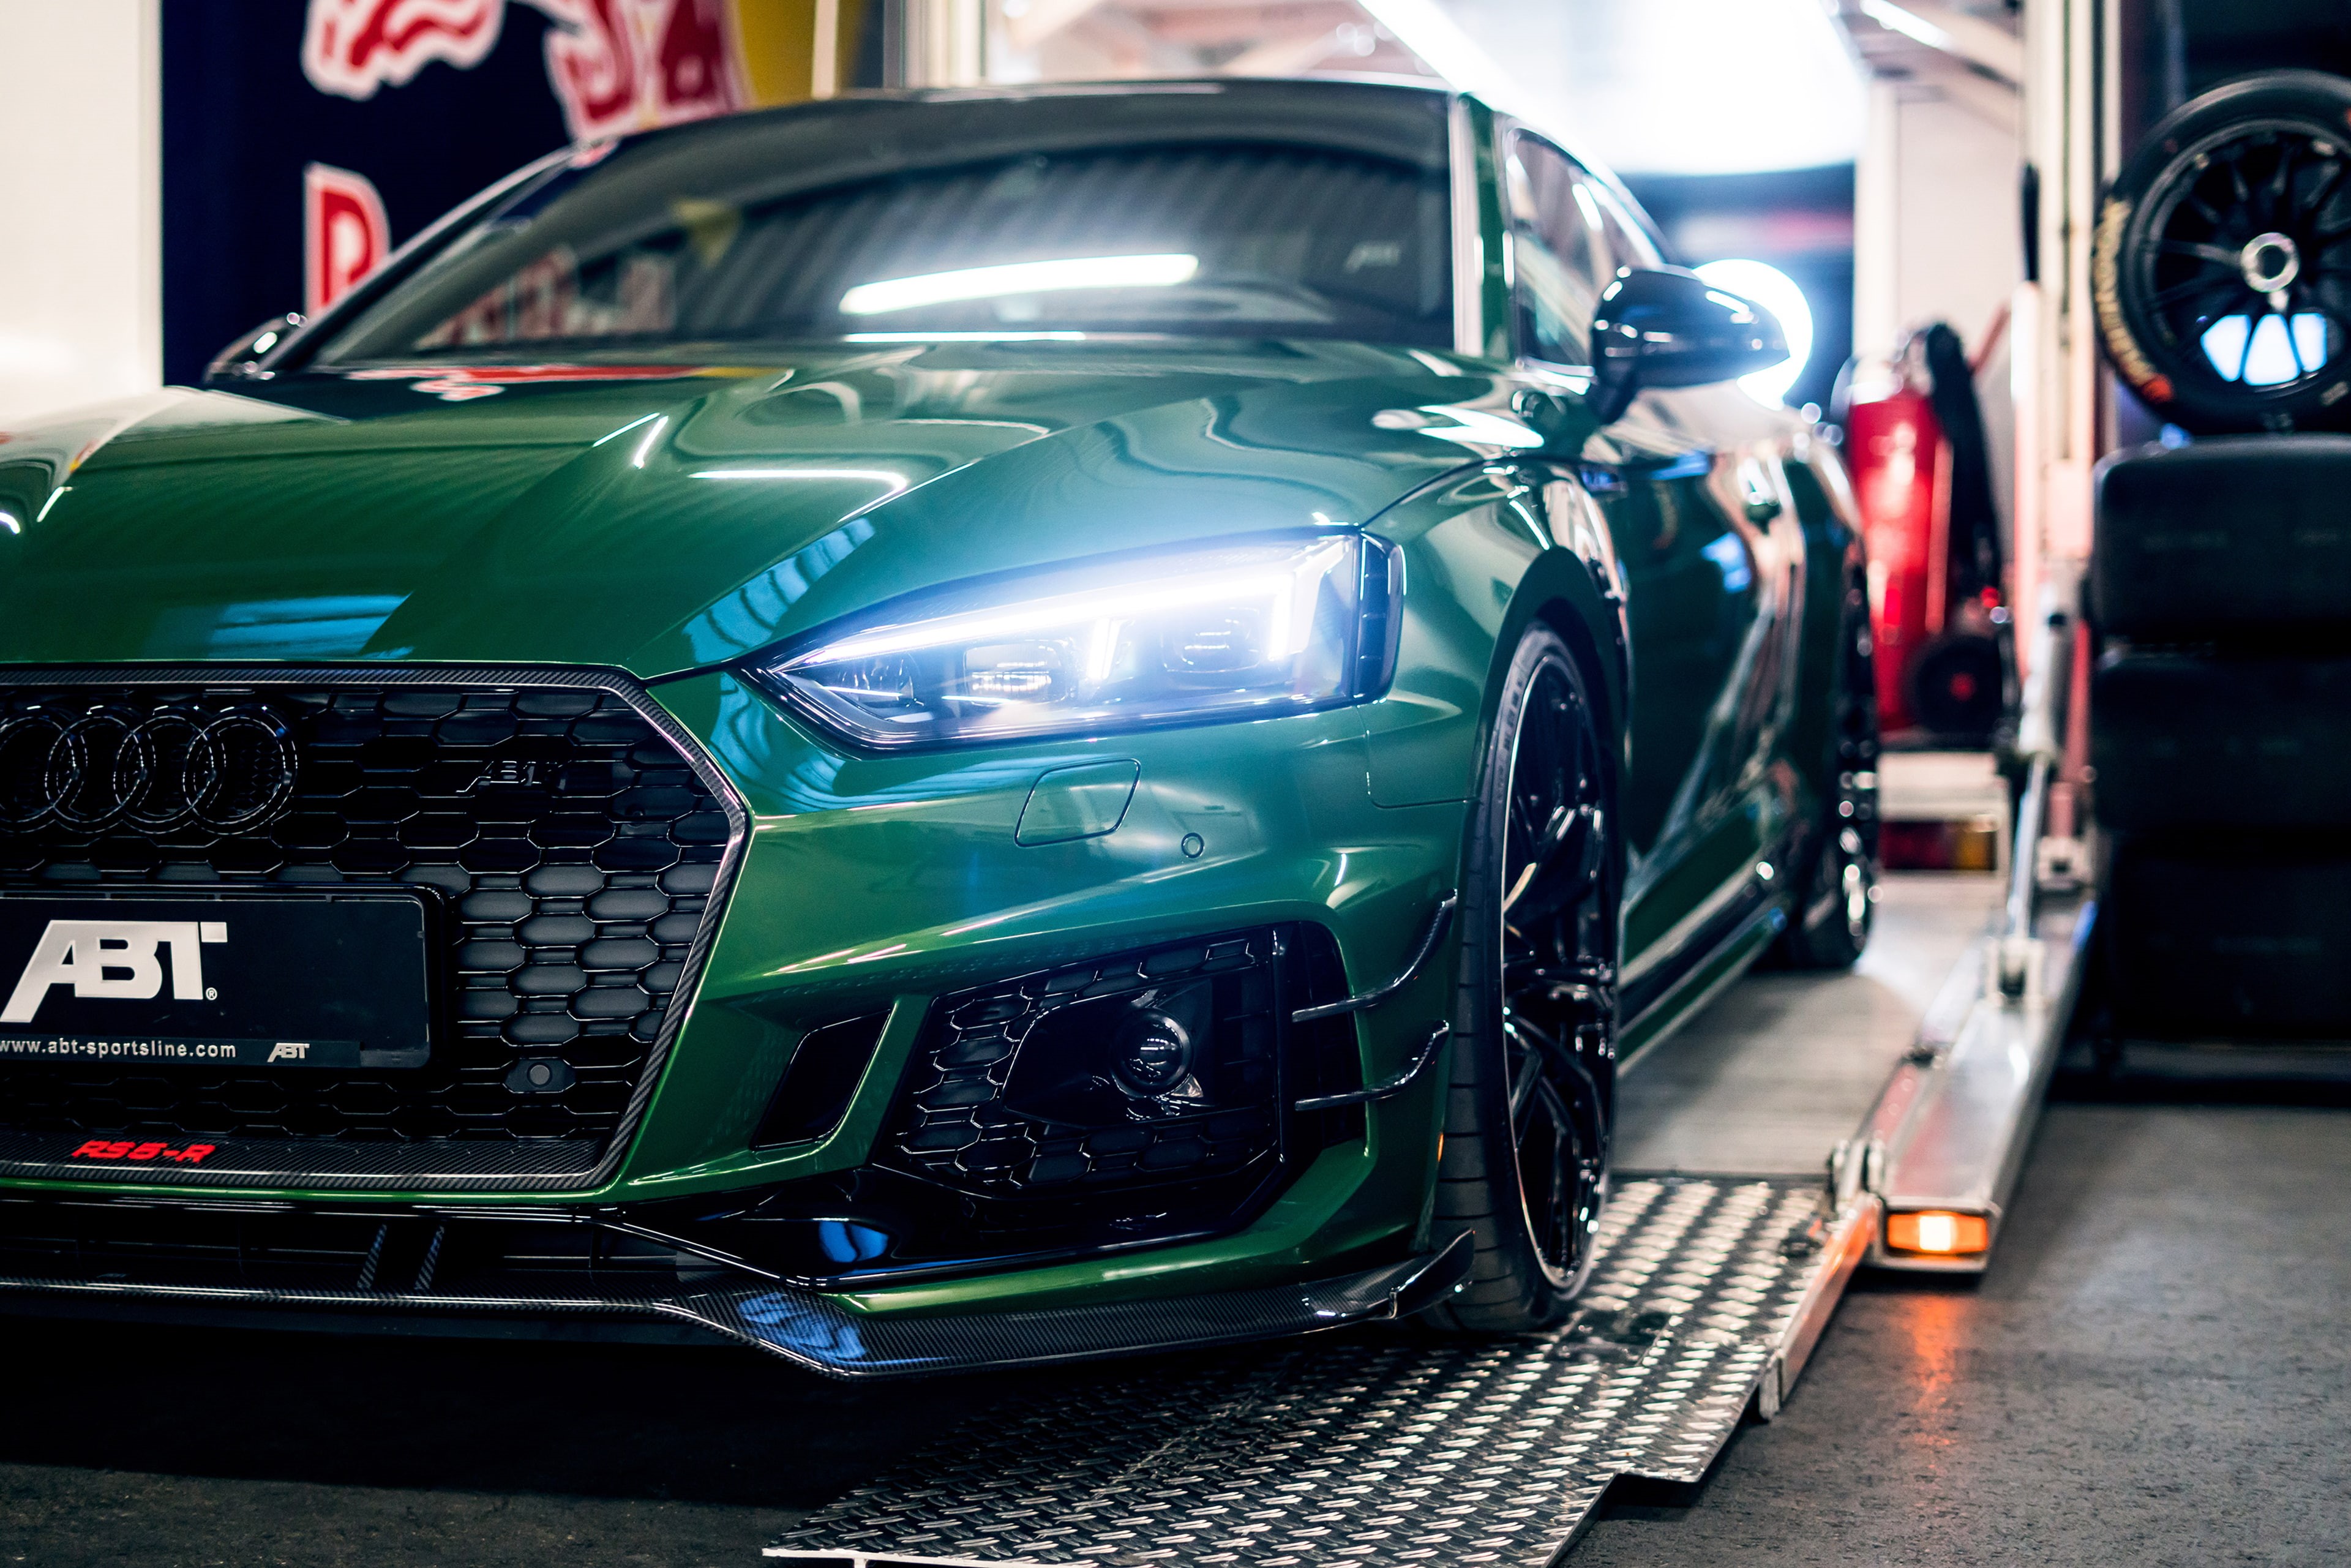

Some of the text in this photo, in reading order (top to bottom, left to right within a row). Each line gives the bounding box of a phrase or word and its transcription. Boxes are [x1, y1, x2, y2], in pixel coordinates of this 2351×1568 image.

[0, 1037, 236, 1059] www.abt-sportsline.com
[267, 1042, 310, 1062] ABT
[72, 1141, 216, 1162] RS5-R
